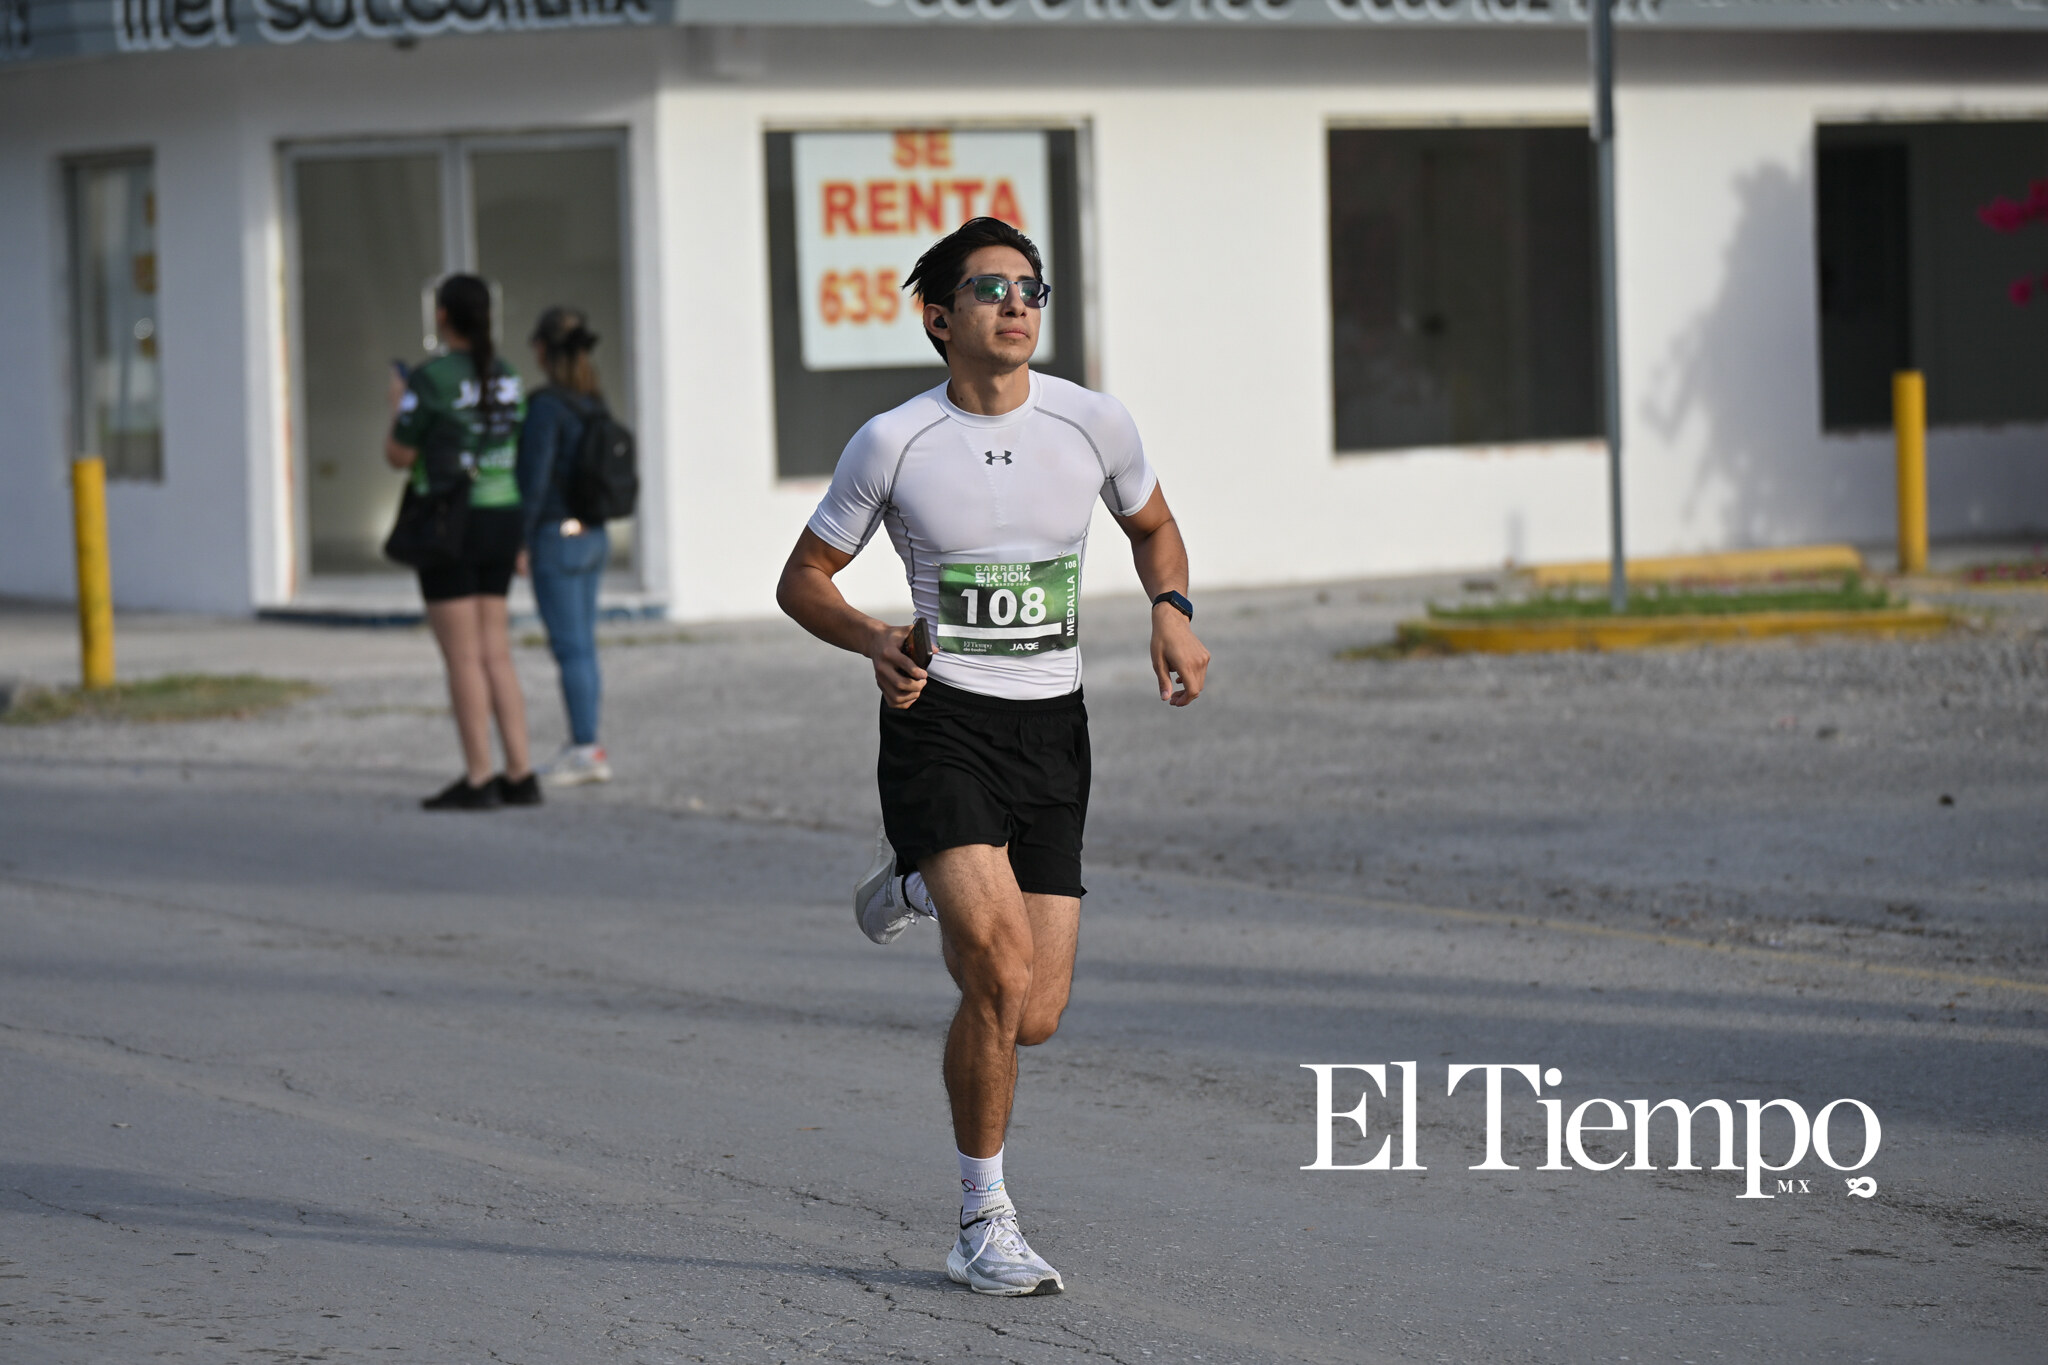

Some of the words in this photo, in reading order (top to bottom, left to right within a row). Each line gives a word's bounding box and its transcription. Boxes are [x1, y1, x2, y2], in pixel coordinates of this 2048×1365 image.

[894, 129, 951, 168] SE
[822, 179, 1026, 236] RENTA
[820, 270, 899, 325] 635
[975, 564, 1031, 572] CARRERA
[1065, 561, 1076, 569] 108
[960, 586, 1047, 626] 108
[1066, 575, 1075, 637] MEDALLA
